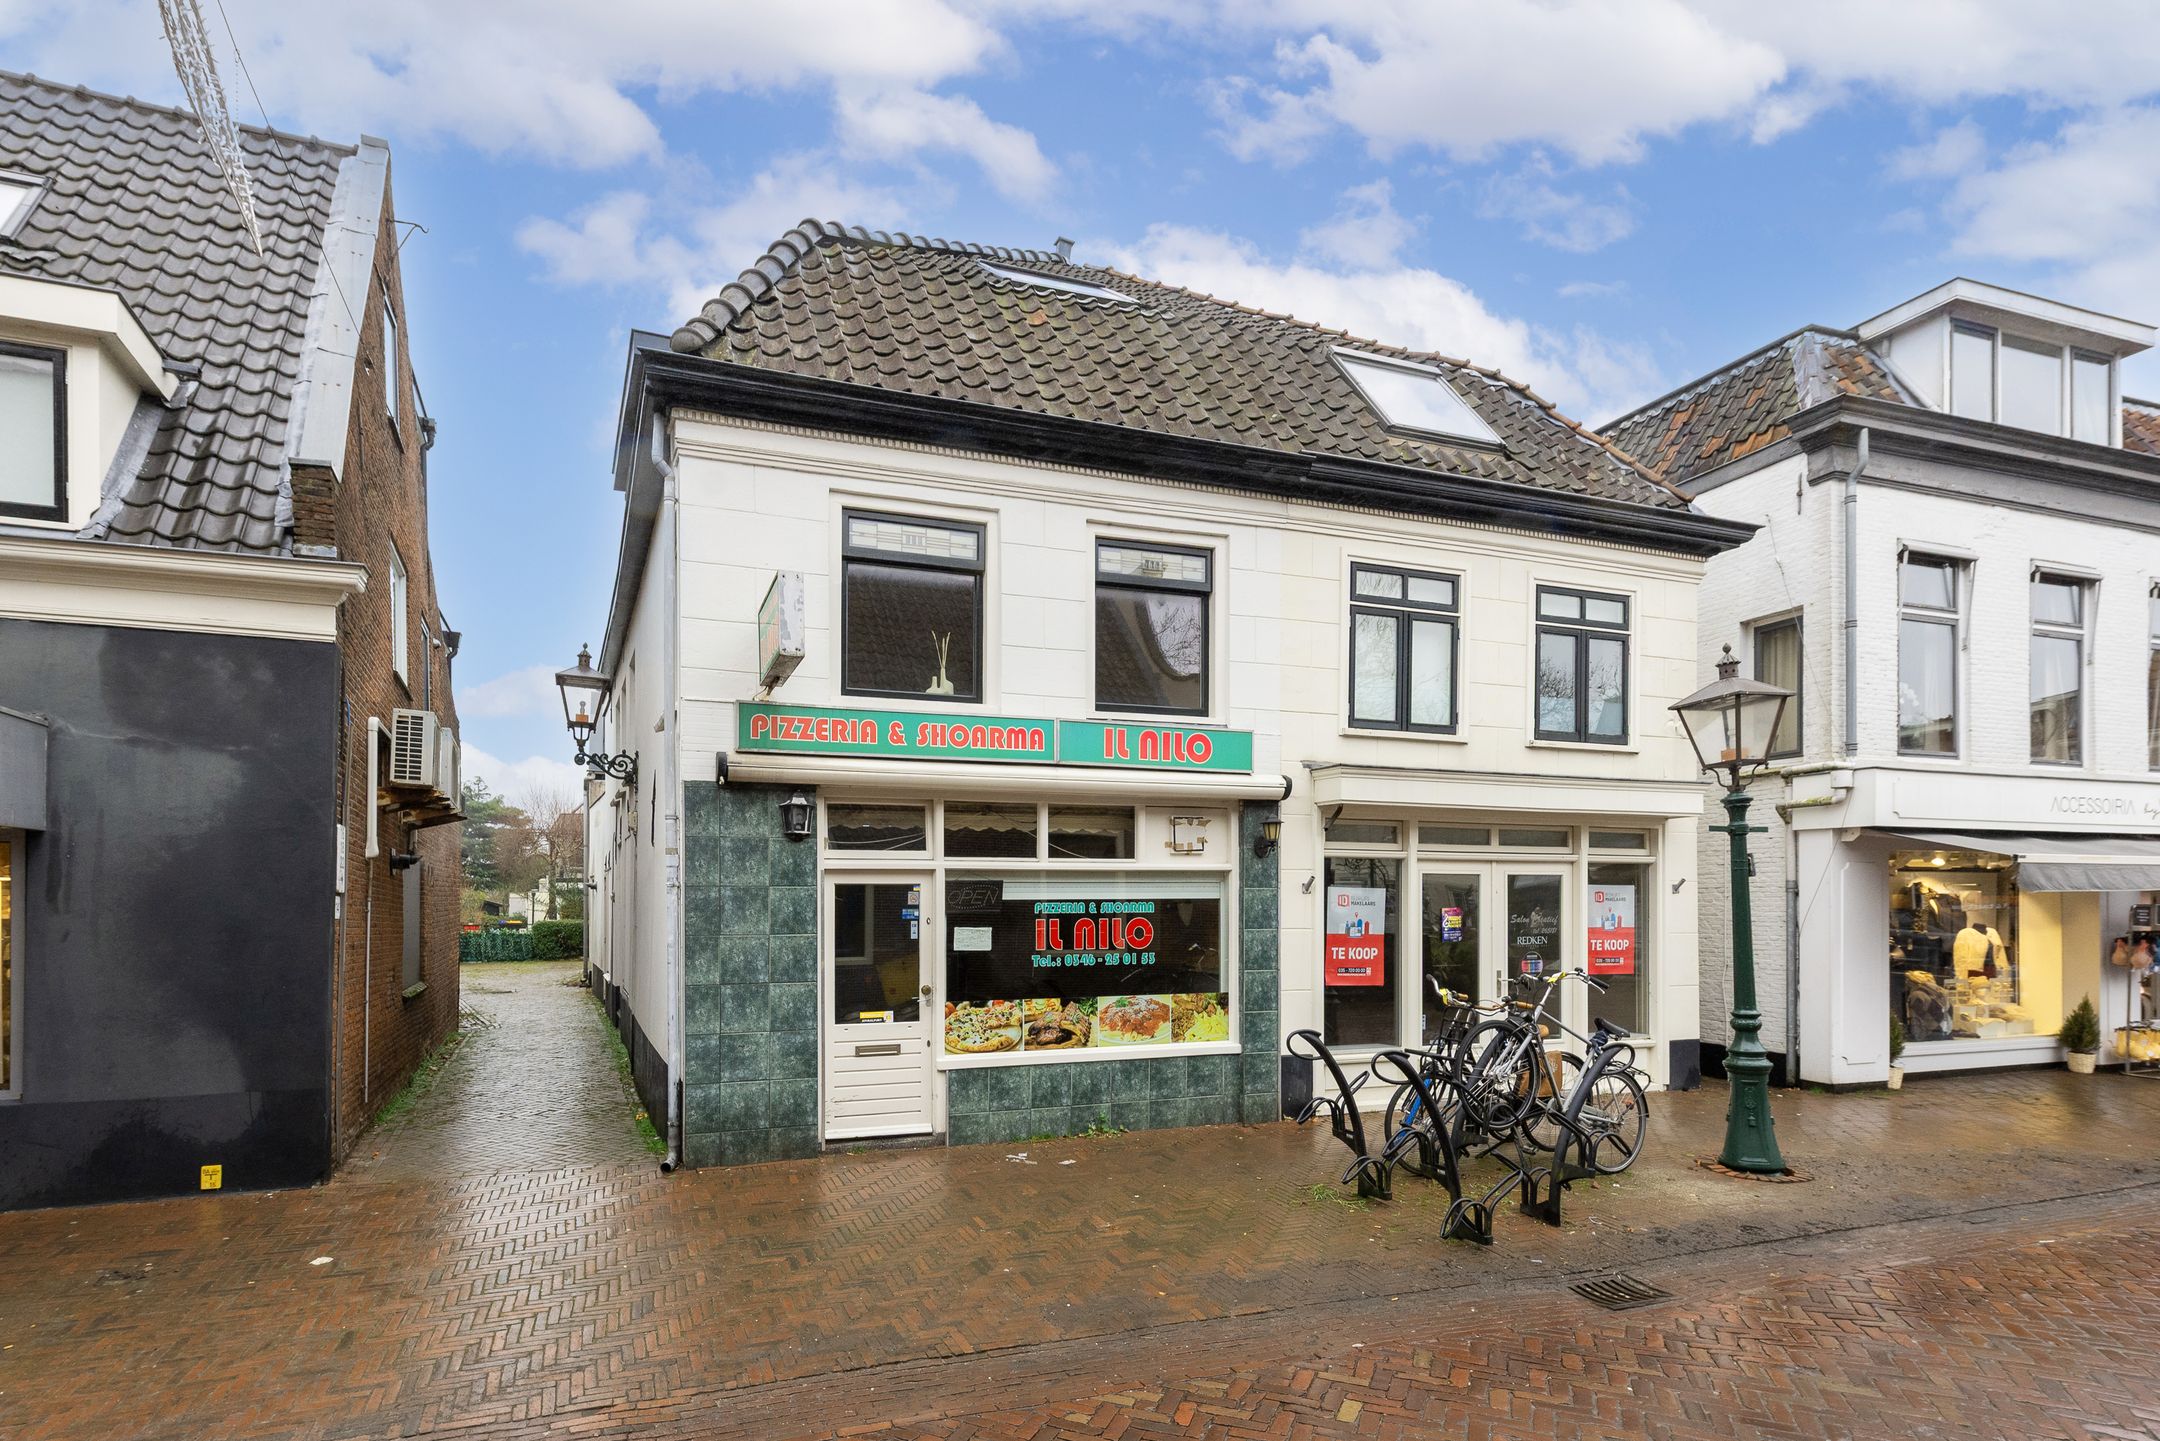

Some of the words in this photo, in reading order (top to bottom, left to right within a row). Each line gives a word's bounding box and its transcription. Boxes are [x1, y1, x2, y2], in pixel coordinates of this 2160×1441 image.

[749, 713, 878, 745] PIZZERIA
[887, 723, 906, 746] &
[916, 721, 1046, 752] SHOARMA
[1103, 726, 1130, 760] IL
[1138, 729, 1213, 765] NILO
[2050, 796, 2136, 815] ACCESSOIRIA
[948, 890, 999, 905] OPEN
[1034, 901, 1086, 914] PIZZERIA
[1088, 901, 1097, 914] &
[1100, 901, 1155, 914] SHOARMA
[1035, 917, 1063, 951] IL
[1073, 917, 1154, 950] NILO
[1517, 936, 1547, 945] REDKEN
[1590, 940, 1602, 951] TE
[1604, 939, 1630, 951] KOOP
[1064, 954, 1096, 967] 0346
[1104, 953, 1120, 966] 25
[1122, 952, 1137, 965] 01
[1141, 952, 1156, 965] 53
[1331, 947, 1345, 959] TE
[1348, 947, 1378, 959] KOOP
